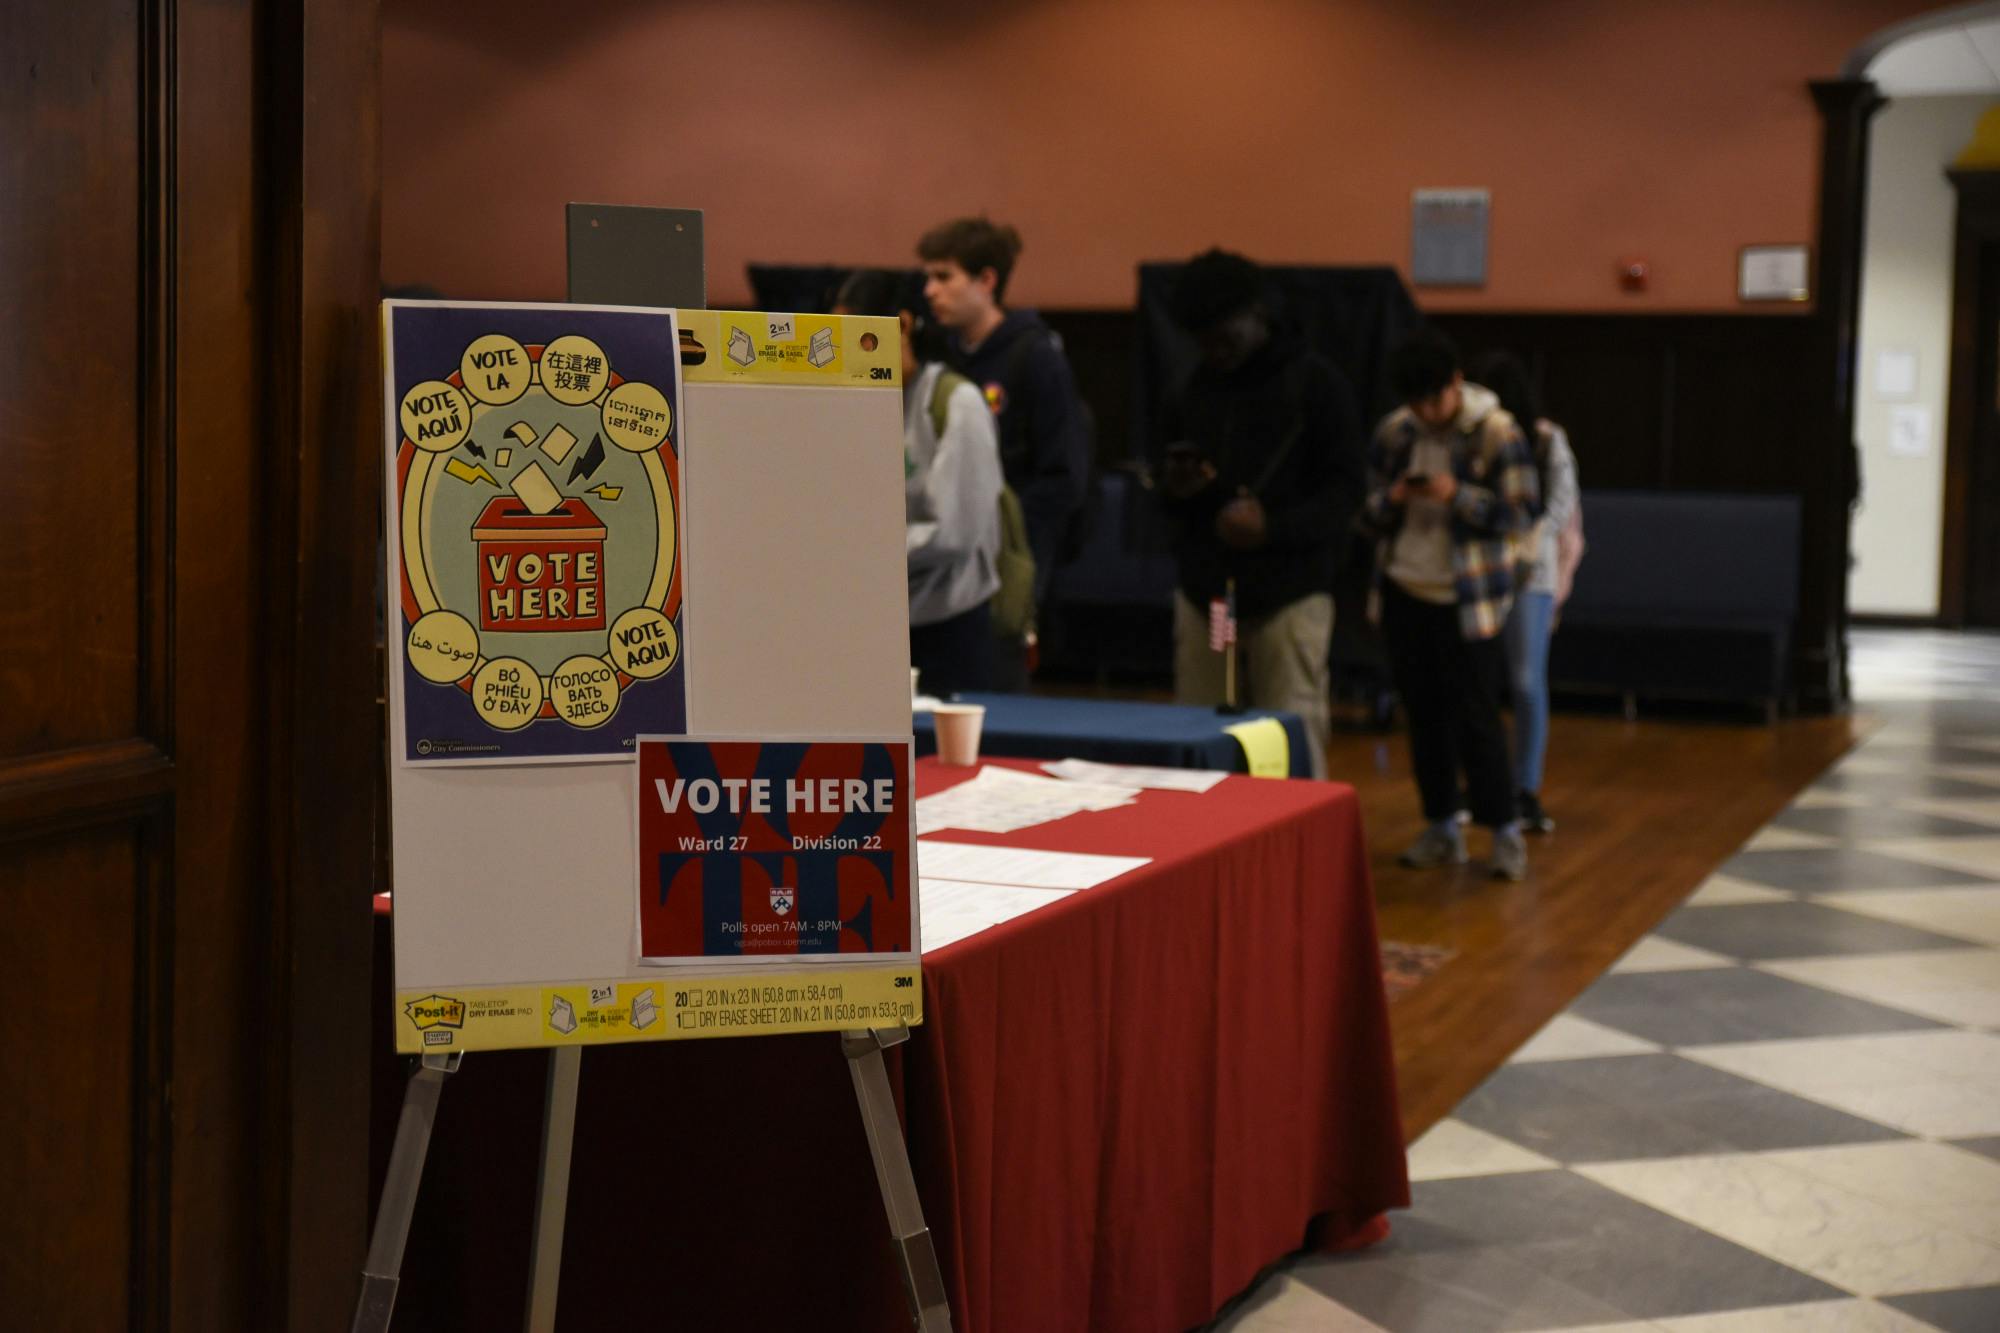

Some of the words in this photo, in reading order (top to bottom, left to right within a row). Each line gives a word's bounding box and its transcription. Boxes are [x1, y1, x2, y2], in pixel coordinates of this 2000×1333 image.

[770, 325, 778, 334] 2
[470, 349, 518, 370] VOTE
[547, 351, 602, 375] 在這裡
[779, 350, 785, 358] &
[486, 373, 510, 391] LA
[555, 373, 591, 392] 投票
[870, 368, 892, 380] 3M
[405, 390, 457, 417] VOTE
[417, 410, 463, 441] AQUÍ
[488, 552, 598, 584] VOTE
[490, 587, 598, 621] HERE
[411, 632, 432, 650] هنا
[616, 620, 666, 647] VOTE
[437, 642, 475, 661] صوت
[627, 641, 671, 670] AQUI
[554, 669, 611, 689] ГОЛОСО
[568, 686, 602, 702] ВАТЬ
[566, 701, 609, 720] ЗДЕСЬ
[654, 778, 771, 814] VOTE
[786, 778, 894, 813] HERE
[678, 836, 724, 851] Ward
[729, 836, 748, 850] 27
[792, 836, 858, 850] Division
[863, 836, 882, 849] 22
[721, 921, 748, 933] Polls
[751, 922, 780, 935] open
[783, 921, 808, 932] 7AM
[818, 920, 842, 932] 8PM
[894, 977, 913, 987] 3M
[592, 989, 599, 999] 2
[676, 992, 688, 1007] 20
[706, 990, 718, 1006] 20
[720, 989, 729, 1005] IN
[730, 993, 735, 1004] x
[738, 988, 749, 1005] 23
[752, 988, 760, 1003] IN
[786, 989, 799, 1002] cm
[800, 989, 806, 1001] x
[828, 984, 843, 1002] cm)
[414, 1006, 459, 1018] Post-it
[469, 1010, 486, 1018] DRY
[489, 1009, 515, 1017] ERASE
[470, 1000, 508, 1009] TABLETOP
[600, 1015, 606, 1023] &
[676, 1013, 681, 1028] 1
[700, 1011, 717, 1027] DRY
[720, 1009, 748, 1026] ERASE
[750, 1008, 777, 1024] SHEET
[780, 1007, 791, 1023] 20
[794, 1006, 802, 1022] IN
[803, 1010, 809, 1021] x
[811, 1006, 820, 1021] 21
[824, 1005, 833, 1020] IN
[858, 1006, 870, 1019] cm
[872, 1006, 877, 1018] x
